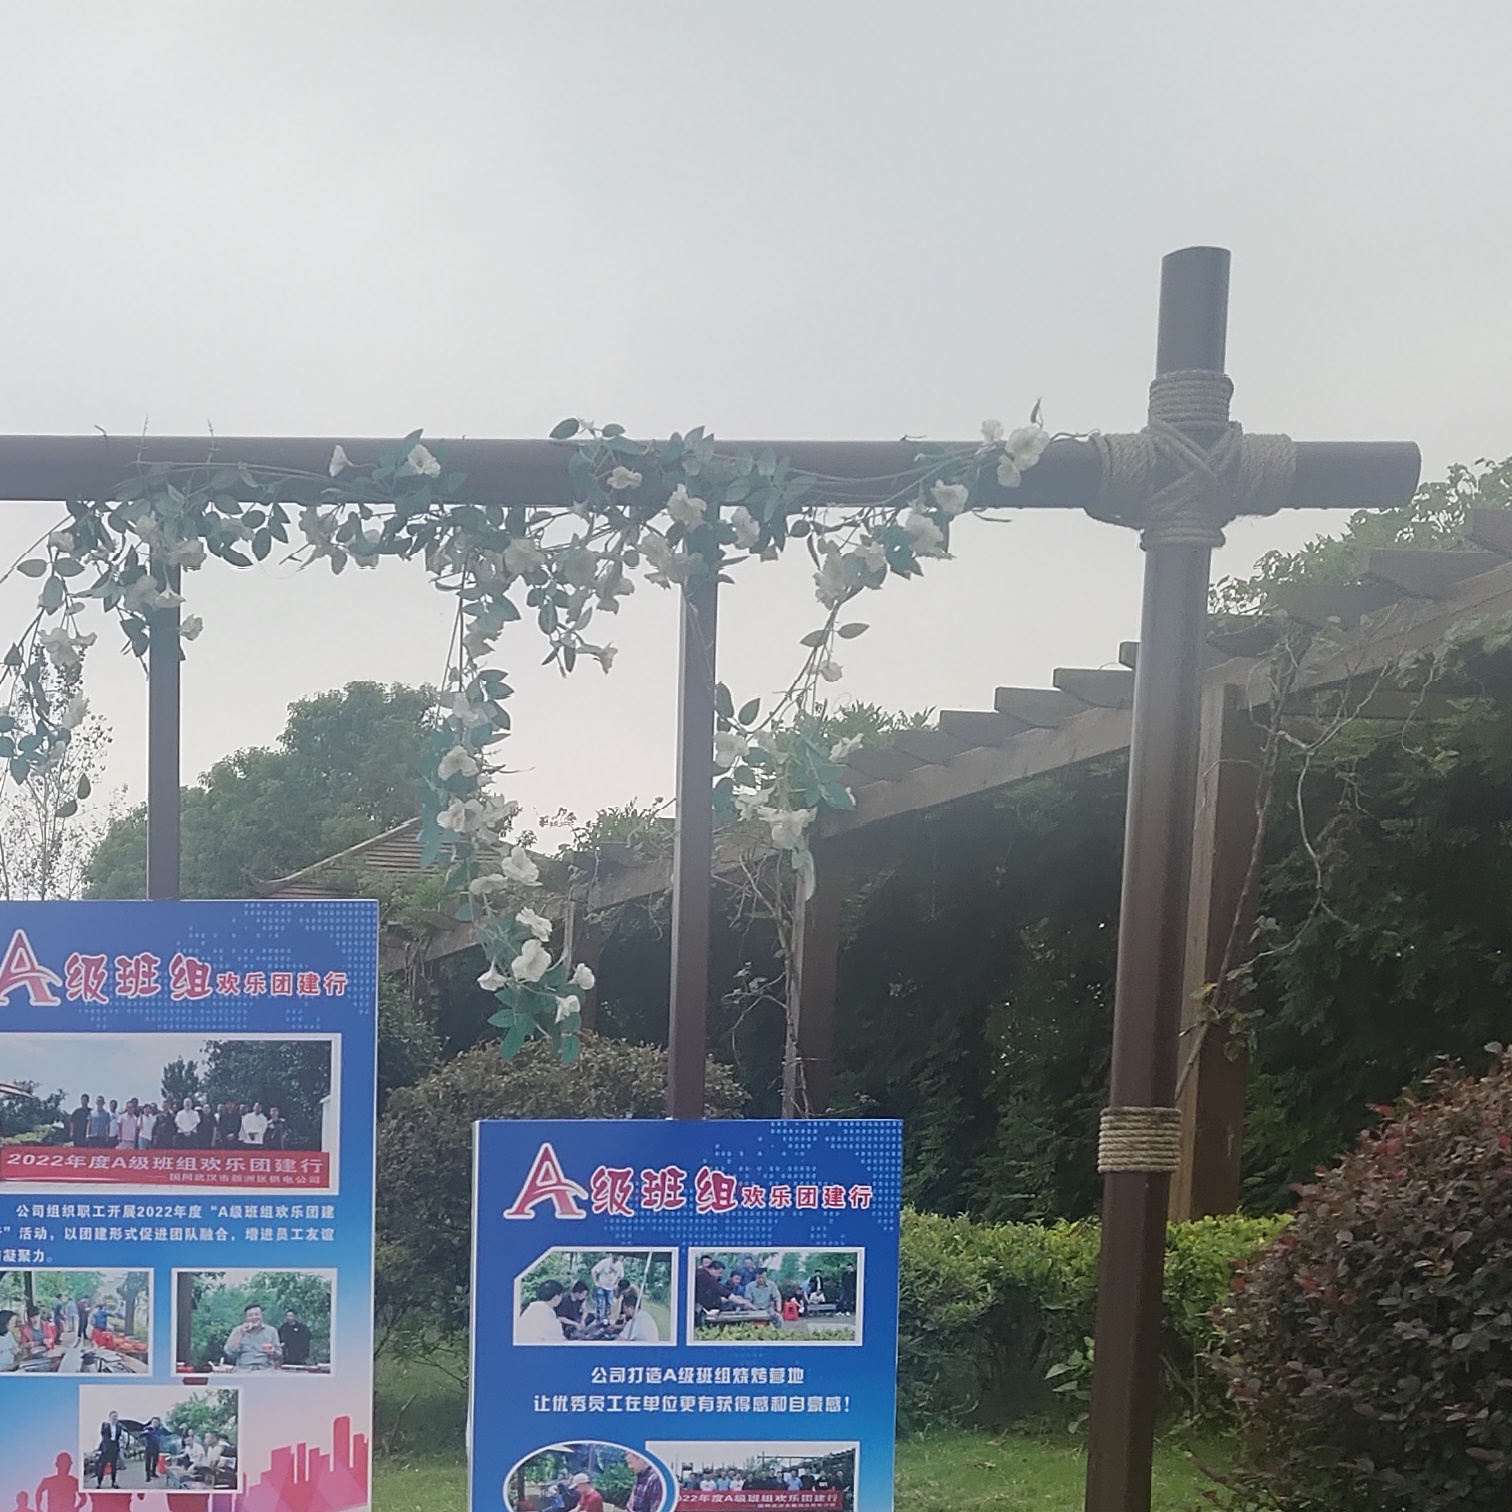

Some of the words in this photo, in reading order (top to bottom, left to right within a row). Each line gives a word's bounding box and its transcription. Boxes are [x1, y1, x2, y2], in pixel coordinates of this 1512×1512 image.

[6, 1153, 324, 1174] 2022年度A级班组欢乐团建行
[503, 1141, 874, 1219] A级班组欢乐团建行
[591, 1367, 805, 1384] 公司打造A级班组烧烤营地
